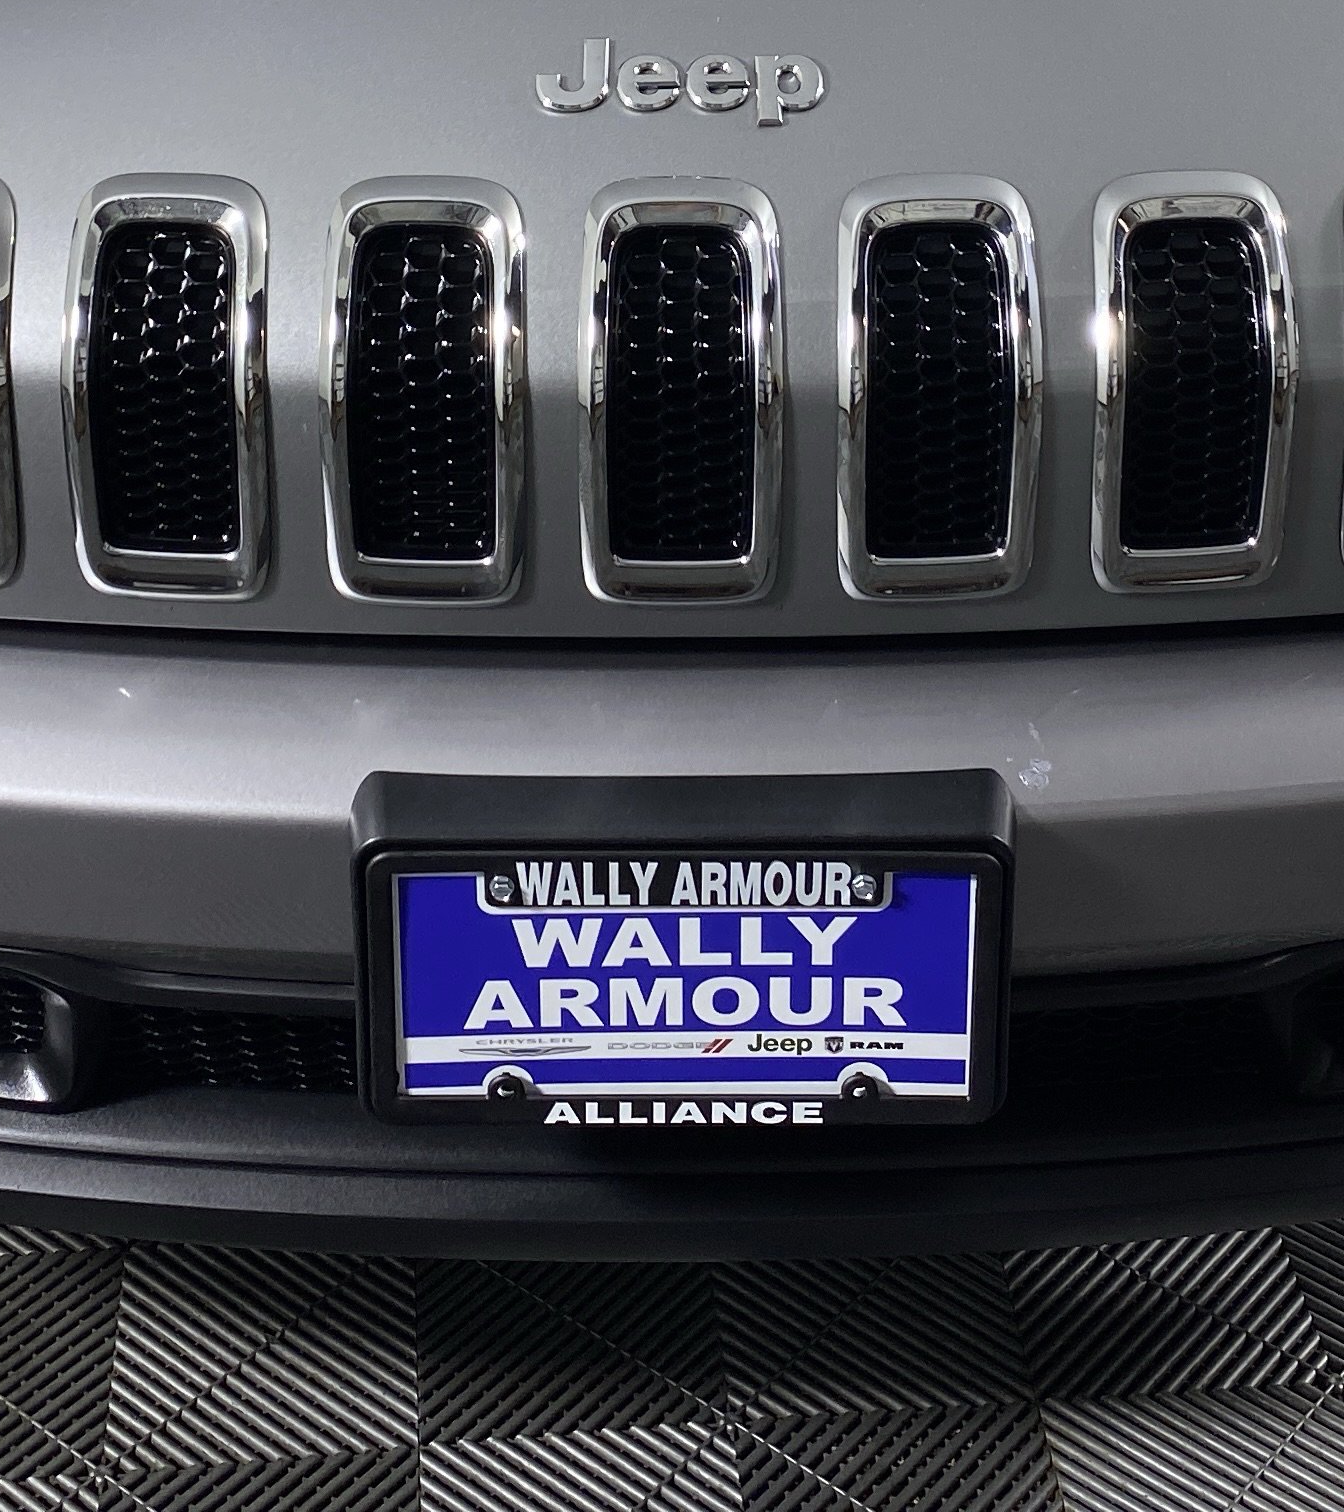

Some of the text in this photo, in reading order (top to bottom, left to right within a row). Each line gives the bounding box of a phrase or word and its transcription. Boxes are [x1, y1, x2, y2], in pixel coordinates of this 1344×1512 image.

[535, 37, 825, 127] Jeep
[515, 861, 851, 907] WALLY ARMOUR
[511, 916, 858, 968] WALLY
[463, 977, 907, 1031] ARMOUR
[475, 1037, 574, 1045] CHRYSLER
[747, 1033, 813, 1055] Jeep
[849, 1041, 904, 1050] RAM
[544, 1101, 824, 1124] ALLIANCE
